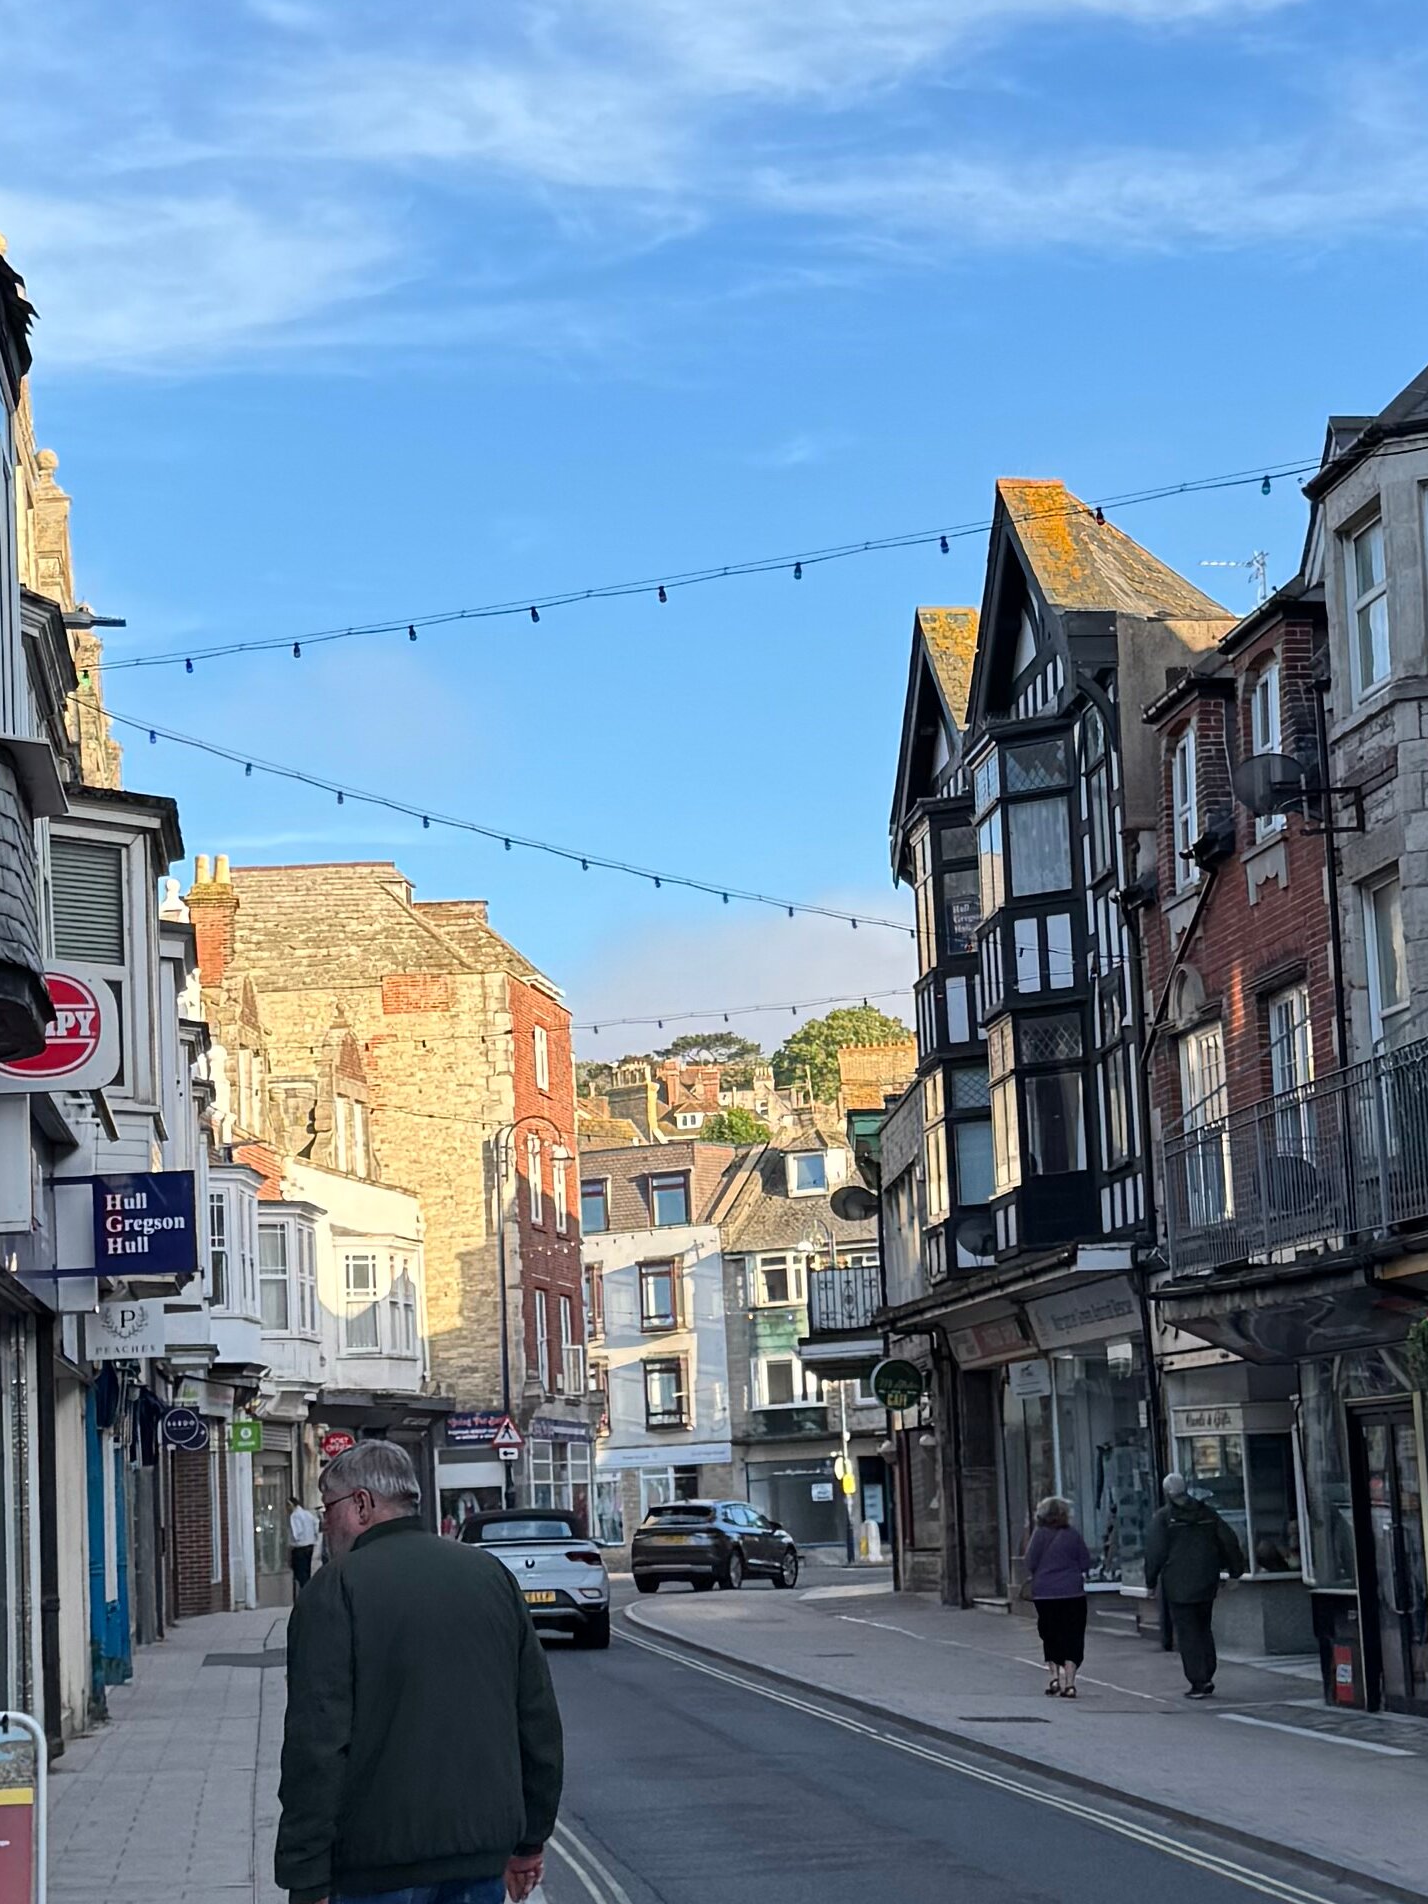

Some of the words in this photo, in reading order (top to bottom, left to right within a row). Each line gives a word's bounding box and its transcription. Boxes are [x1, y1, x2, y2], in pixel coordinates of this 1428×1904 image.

[105, 1193, 147, 1211] Hull
[105, 1215, 185, 1235] Gregson
[107, 1236, 149, 1255] Hull
[120, 1310, 136, 1328] P
